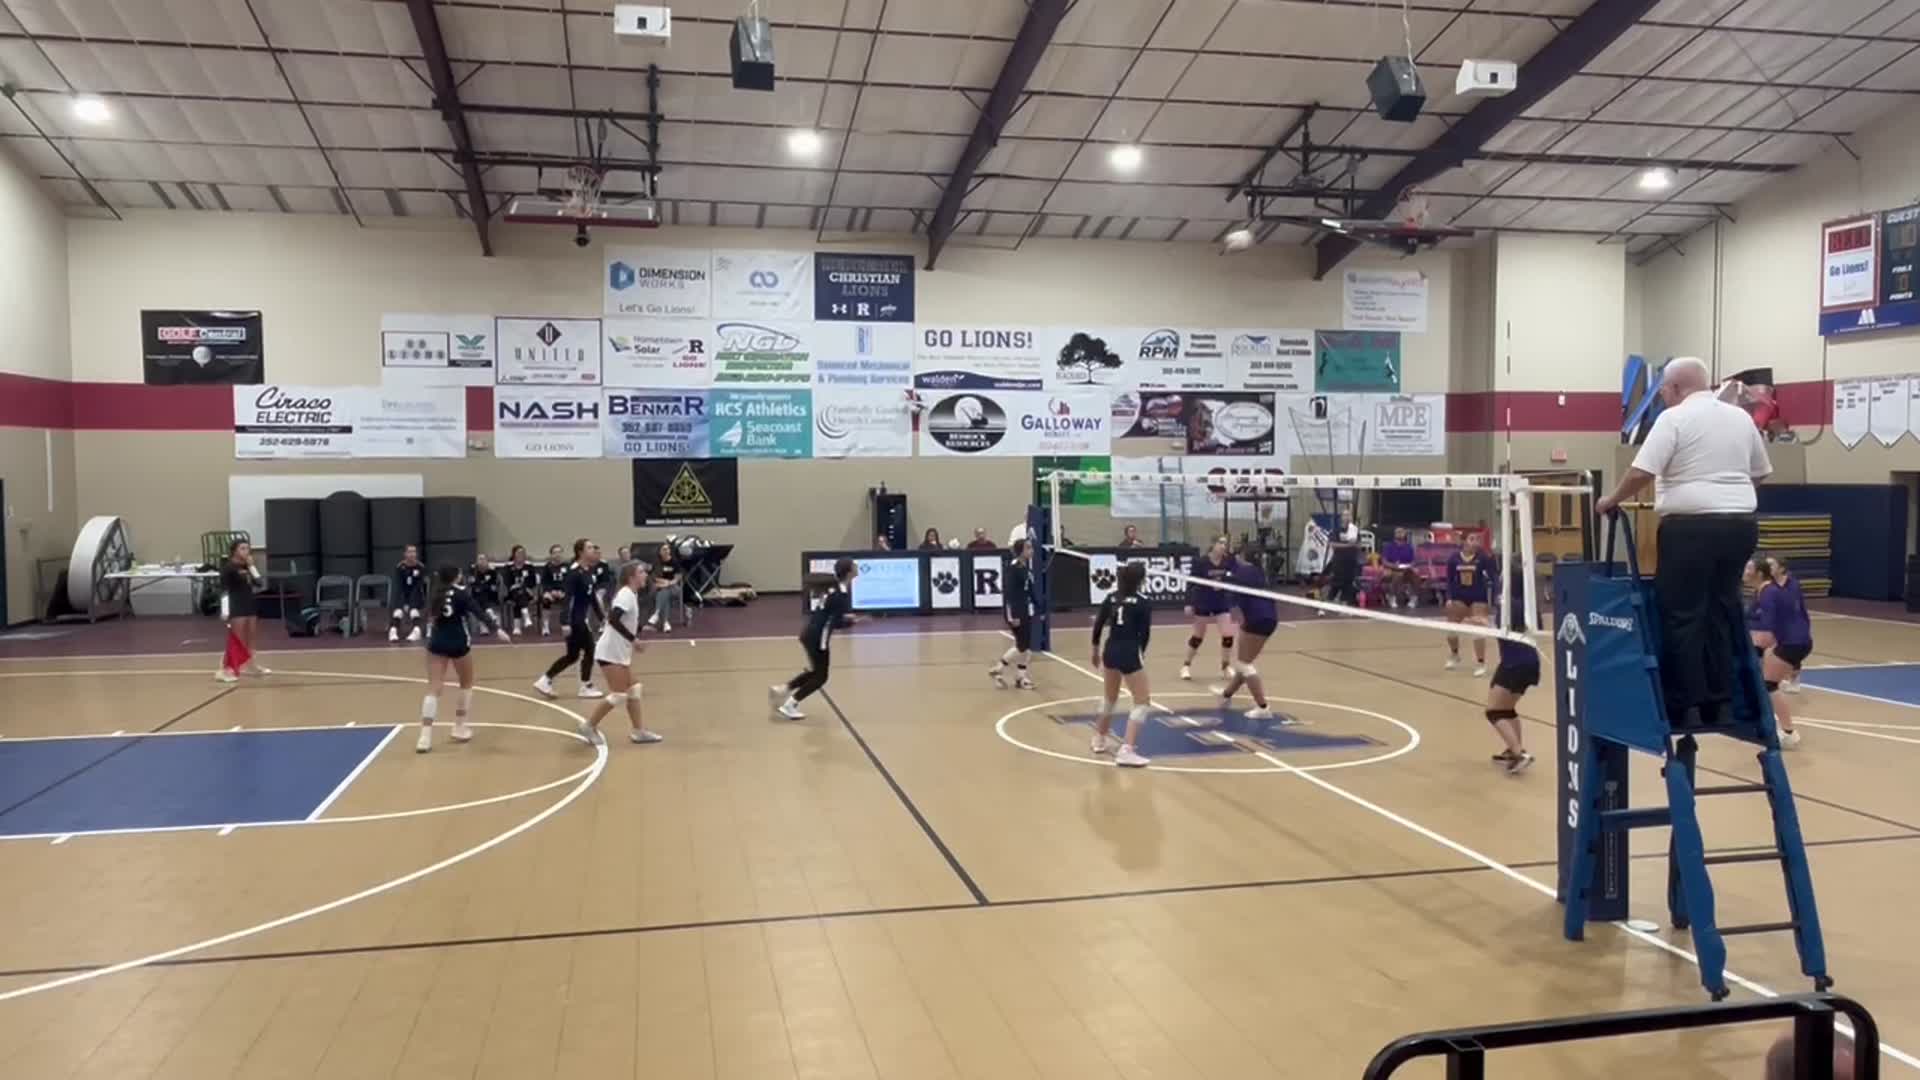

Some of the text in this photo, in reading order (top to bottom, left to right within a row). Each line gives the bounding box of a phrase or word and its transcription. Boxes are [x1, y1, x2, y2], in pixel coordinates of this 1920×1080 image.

[639, 267, 706, 280] DIMENSION
[1829, 264, 1841, 276] Go
[639, 280, 685, 289] WORKS
[829, 272, 901, 284] CHRISTIAN
[842, 284, 888, 297] LIONS
[646, 304, 662, 313] Go
[857, 302, 870, 316] R
[925, 329, 1033, 349] GO LIONS!
[634, 345, 660, 354] Solar
[688, 339, 704, 353] R
[1139, 346, 1178, 358] RPM
[256, 386, 332, 410] Ciraco
[499, 402, 599, 419] NASH
[715, 402, 807, 417] RCS Athletics
[256, 410, 332, 423] ELECTRIC
[1021, 414, 1102, 431] GALLOWAY
[1380, 406, 1427, 427] MPE
[746, 421, 802, 433] Seacoast
[746, 434, 776, 446] Bank
[623, 442, 642, 453] GO
[975, 570, 1002, 595] R
[1116, 606, 1125, 625] 1
[1565, 650, 1580, 829] LIONS
